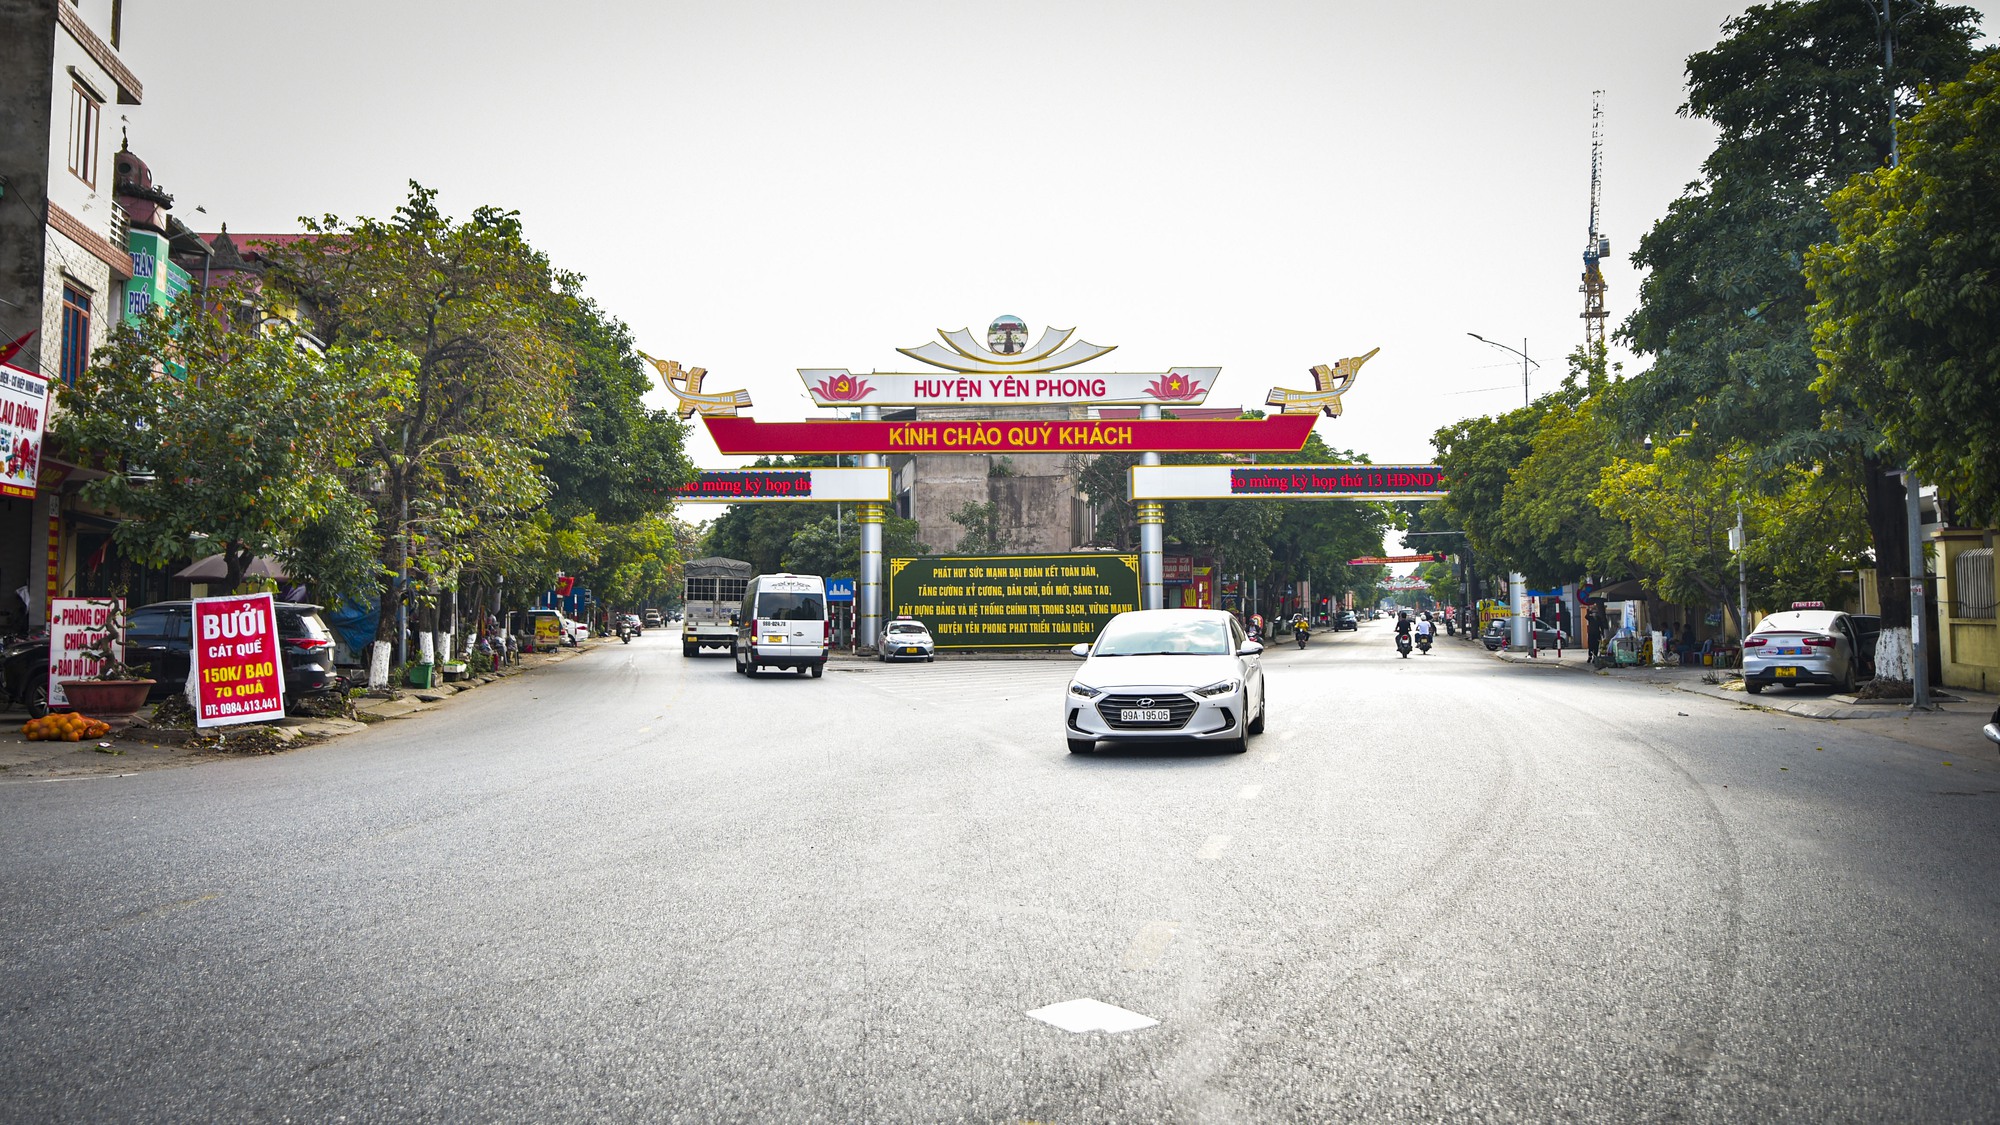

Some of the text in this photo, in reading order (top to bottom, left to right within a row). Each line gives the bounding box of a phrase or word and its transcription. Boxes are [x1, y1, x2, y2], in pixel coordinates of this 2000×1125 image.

[914, 376, 1106, 401] HUYỆN YÊN PHONG
[15, 401, 38, 434] ĐỘNG
[890, 422, 1132, 446] KÍNH CHÀO QUÝ KHÁCH
[703, 478, 742, 494] mừng
[746, 478, 762, 494] kỳ
[766, 478, 790, 494] họp
[1250, 474, 1288, 491] mừng
[1292, 474, 1308, 491] kỳ
[1312, 474, 1337, 490] họp
[1340, 474, 1363, 487] thứ
[1368, 474, 1382, 486] 13
[1388, 474, 1434, 486] HĐND
[933, 564, 1099, 579] PHÁT HUY SỨC MẠNH ĐẠI ĐOÀN KẾT TOÀN DÂN,
[918, 584, 937, 596] TĂNG
[939, 584, 963, 596] CƯỜNG
[966, 583, 975, 596] KỶ
[978, 586, 1004, 597] CƯƠNG,
[1007, 584, 1021, 596] DÂN
[1024, 582, 1040, 597] CHỦ,
[1041, 581, 1053, 595] ĐỔI
[1056, 583, 1071, 596] MỚI,
[1074, 583, 1092, 595] SÁNG
[62, 605, 92, 626] PHÒNG
[899, 603, 912, 615] XÂY
[915, 604, 933, 617] DỰNG
[936, 601, 955, 615] ĐẢNG
[958, 604, 966, 615] VÀ
[969, 603, 978, 617] HỆ
[980, 602, 1004, 615] THỐNG
[1006, 603, 1027, 614] CHÍNH
[1029, 604, 1040, 617] TRỊ
[1042, 605, 1063, 614] TRONG
[1066, 604, 1087, 616] SẠCH,
[1089, 602, 1108, 614] VỮNG
[203, 603, 266, 640] BƯỞI
[939, 621, 962, 635] HUYỆN
[965, 621, 979, 633] YÊN
[982, 624, 1006, 633] PHONG
[1030, 619, 1050, 633] TRIỂN
[1052, 621, 1070, 633] TOÀN
[208, 638, 262, 658] CÁT QUẾ
[58, 652, 72, 676] BẢO
[85, 659, 97, 676] LAO
[203, 662, 273, 683] 150K/ BAO
[215, 680, 264, 698] 70 QUẢ
[206, 698, 277, 716] ĐT: 0984.413.441
